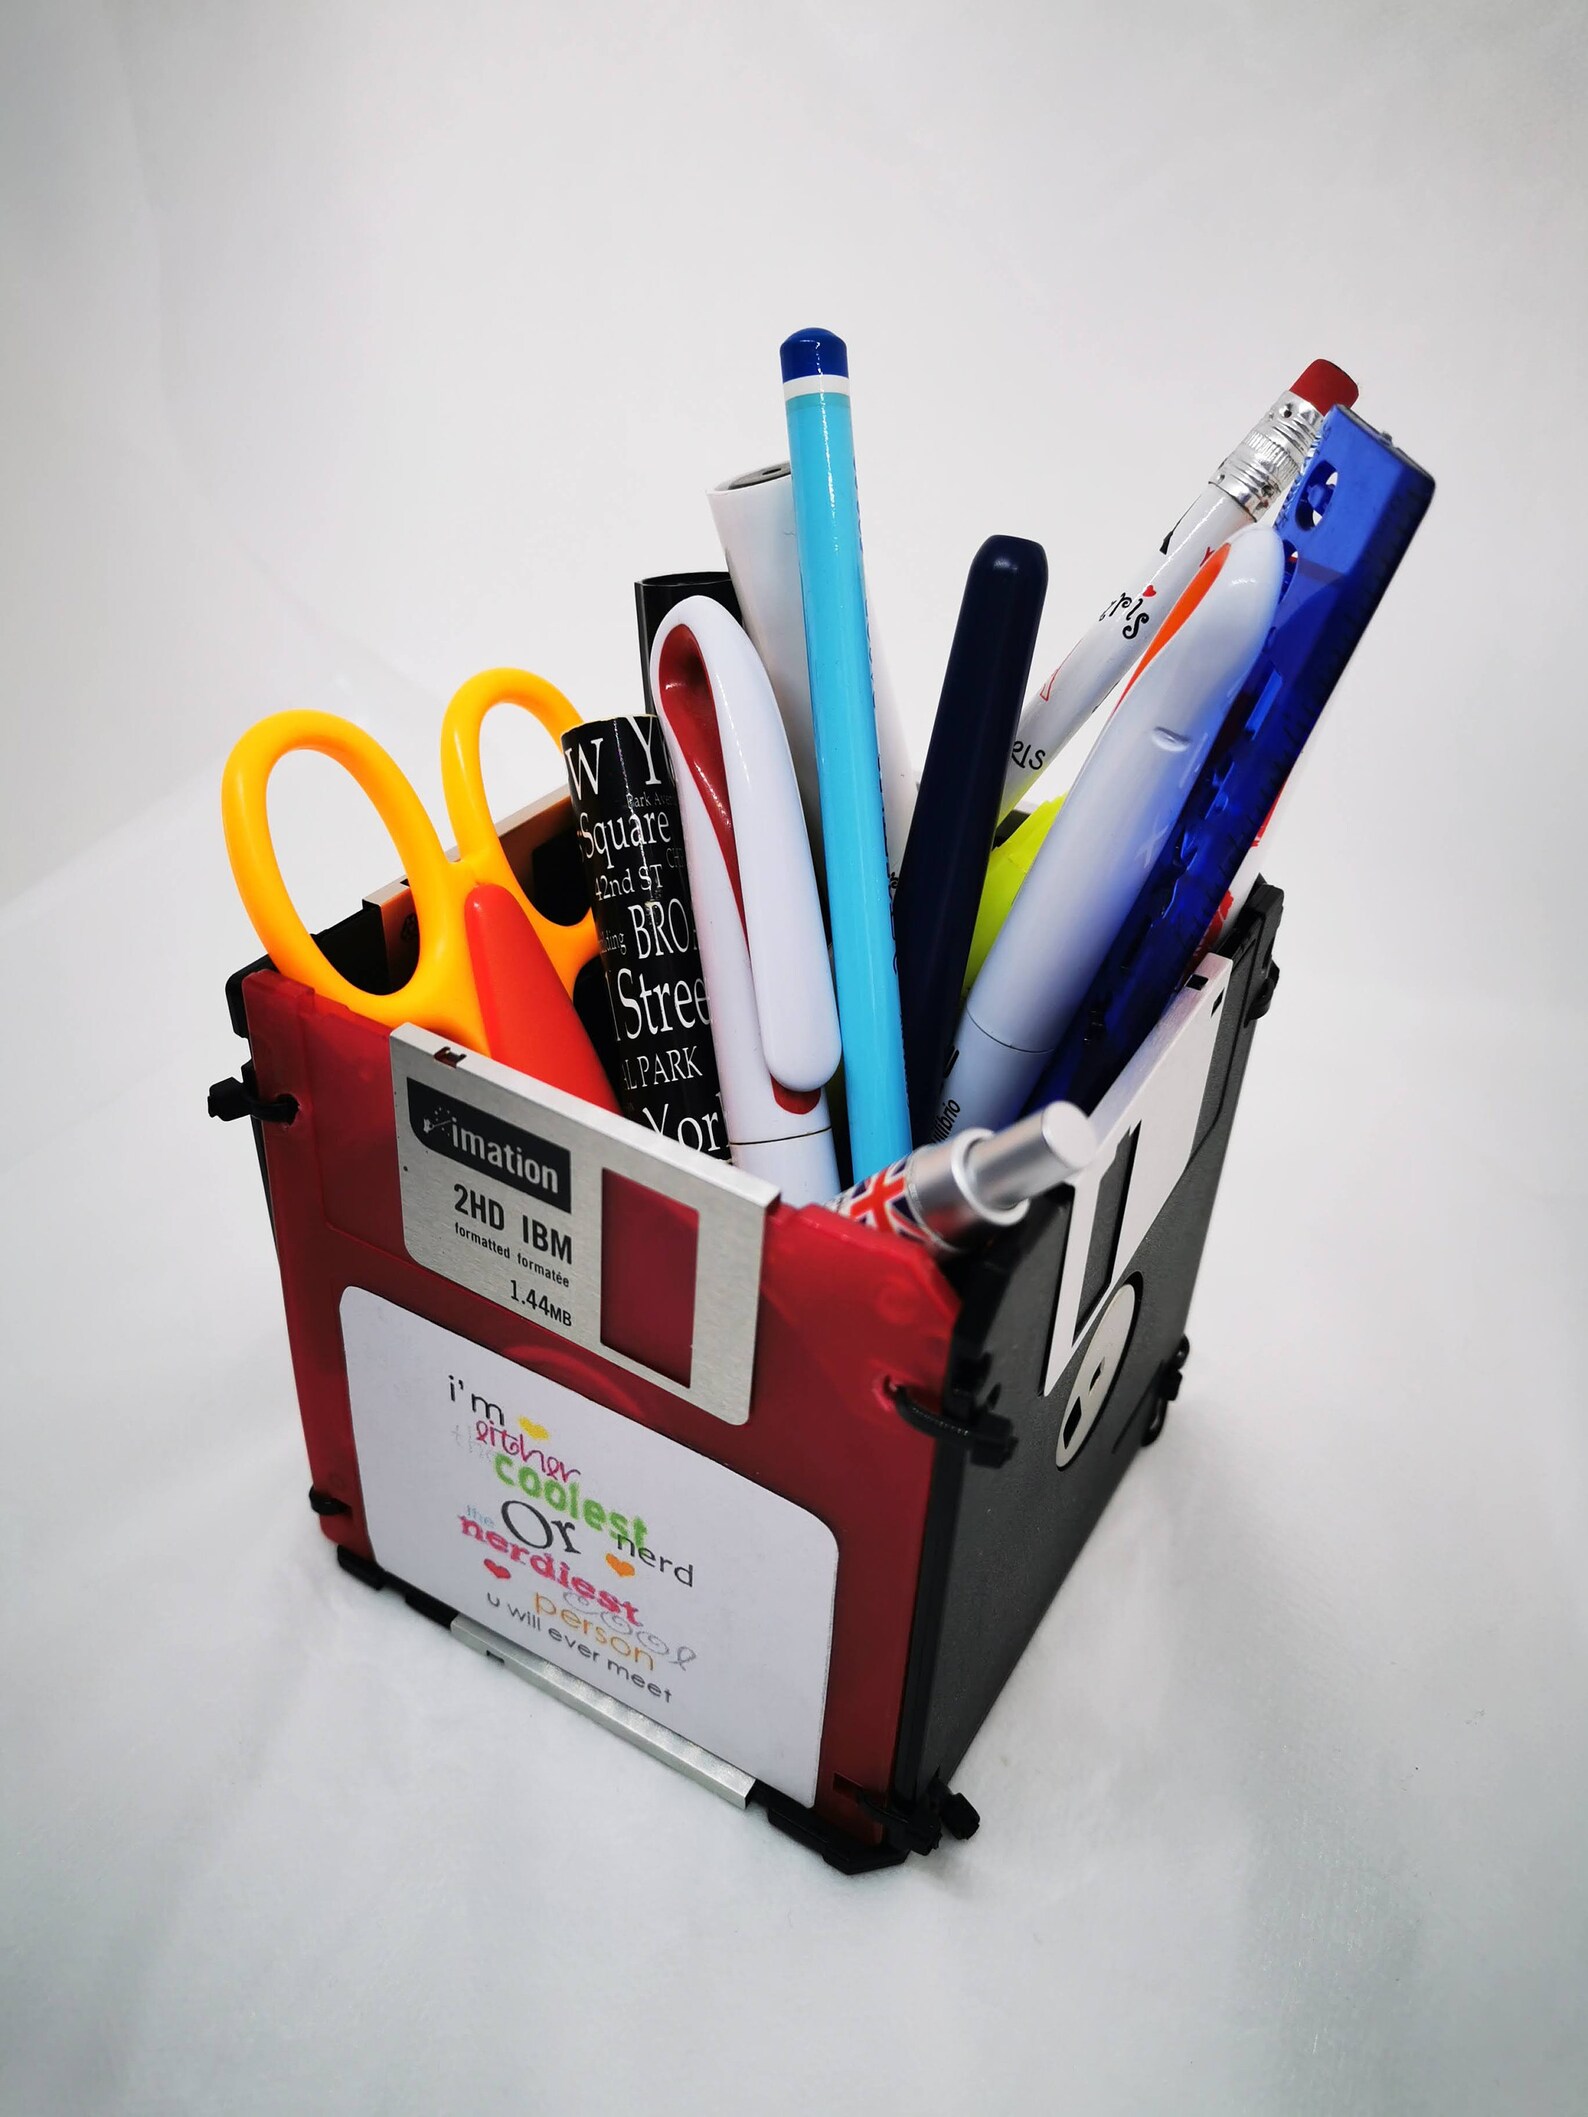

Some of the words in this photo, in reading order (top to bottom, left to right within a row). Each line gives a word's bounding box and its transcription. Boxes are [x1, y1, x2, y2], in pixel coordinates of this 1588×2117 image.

[626, 715, 677, 785] Y
[579, 811, 671, 869] Square
[594, 868, 635, 901] 42nd
[638, 864, 663, 891] ST
[616, 967, 711, 1040] Stree
[637, 1046, 704, 1088] PARK
[450, 1117, 559, 1194] imation
[642, 1092, 731, 1154] Yor
[453, 1183, 505, 1232] 2HD
[522, 1215, 573, 1265] IBM
[455, 1221, 511, 1259] formatted
[517, 1252, 570, 1288] formatée
[510, 1279, 573, 1327] 1.44MB
[448, 1374, 505, 1426] i'm
[476, 1420, 581, 1483] either
[494, 1451, 649, 1549] coolest
[501, 1500, 581, 1554] Or
[457, 1514, 644, 1627] nerdiest
[616, 1533, 694, 1588] nerd
[486, 1592, 500, 1608] u
[507, 1602, 542, 1632] will
[548, 1625, 600, 1663] ever
[607, 1658, 673, 1703] meet
[533, 1592, 655, 1671] person
